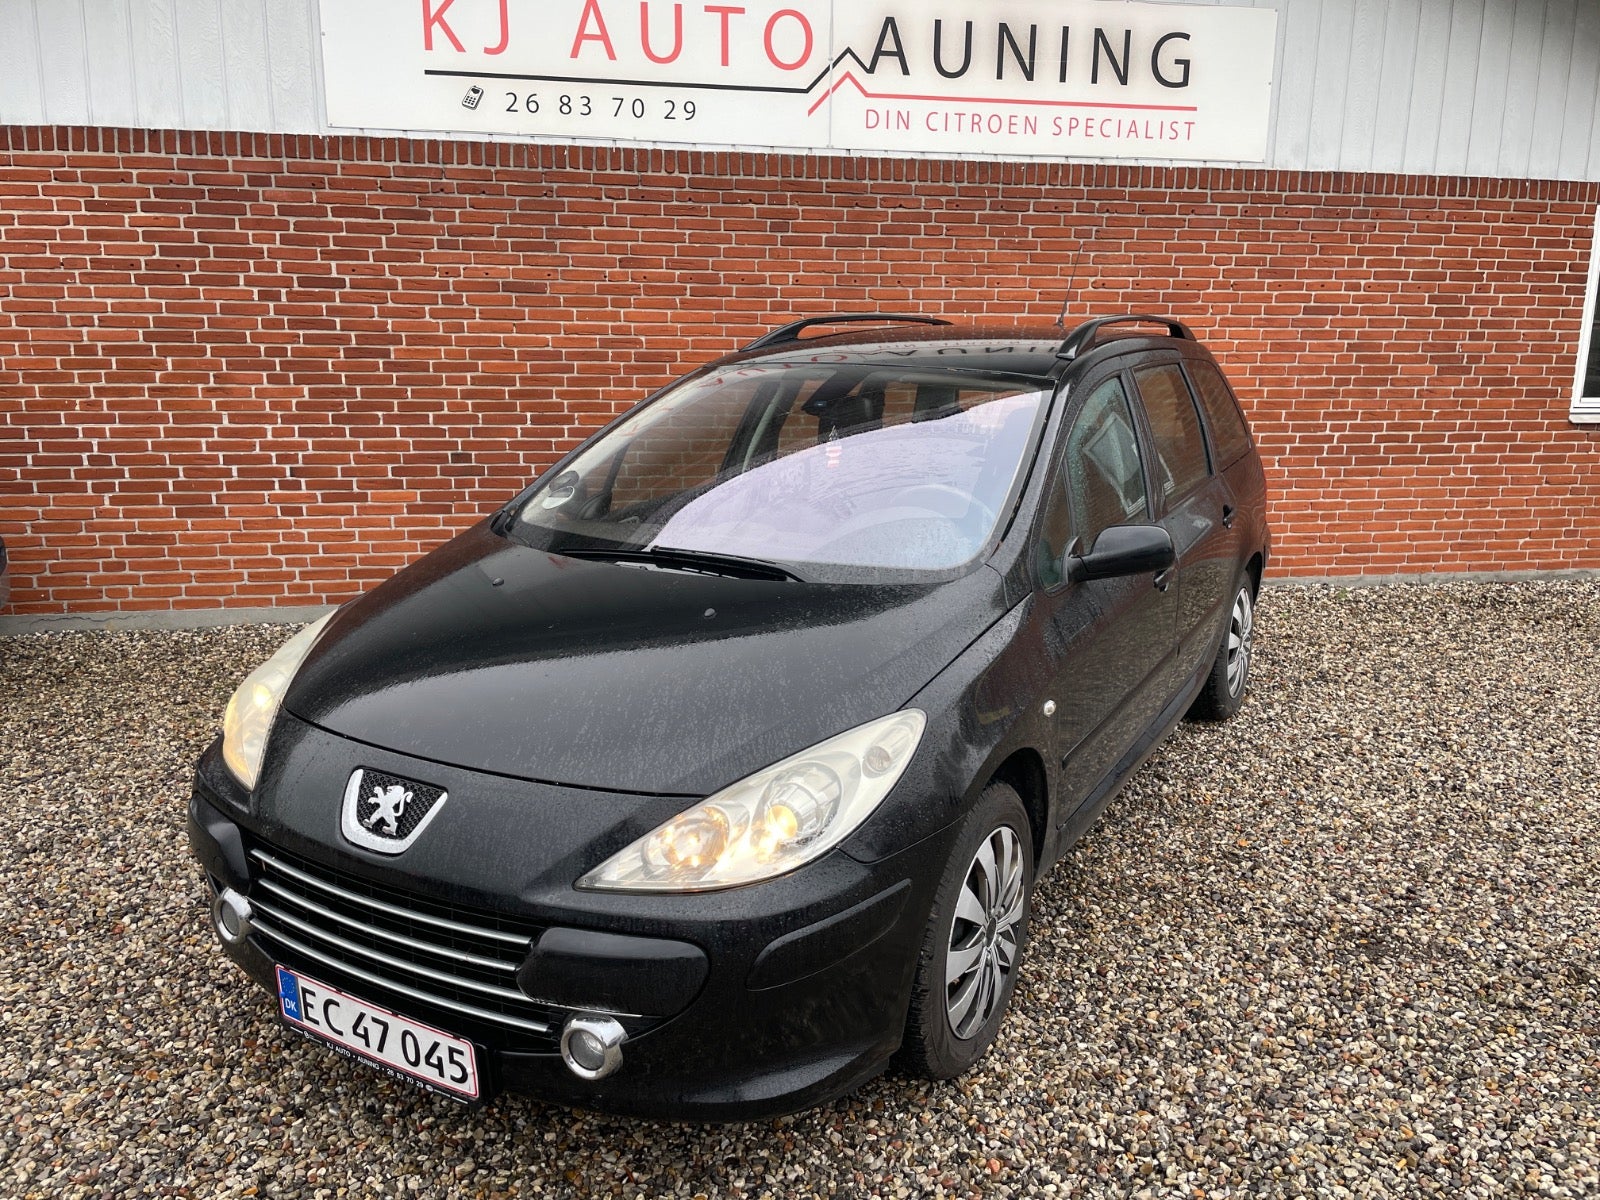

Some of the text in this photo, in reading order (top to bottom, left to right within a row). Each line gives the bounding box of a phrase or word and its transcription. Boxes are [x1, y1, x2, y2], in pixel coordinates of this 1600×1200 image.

[422, 0, 1191, 89] KJ AUTO AUNING
[505, 92, 697, 121] 26 83 70 29
[865, 108, 1196, 141] DIN CITROEN SPECIALIST
[284, 997, 297, 1012] DK
[300, 985, 470, 1084] EC 47 045
[326, 1041, 334, 1050] KJ
[335, 1046, 351, 1057] AUTO
